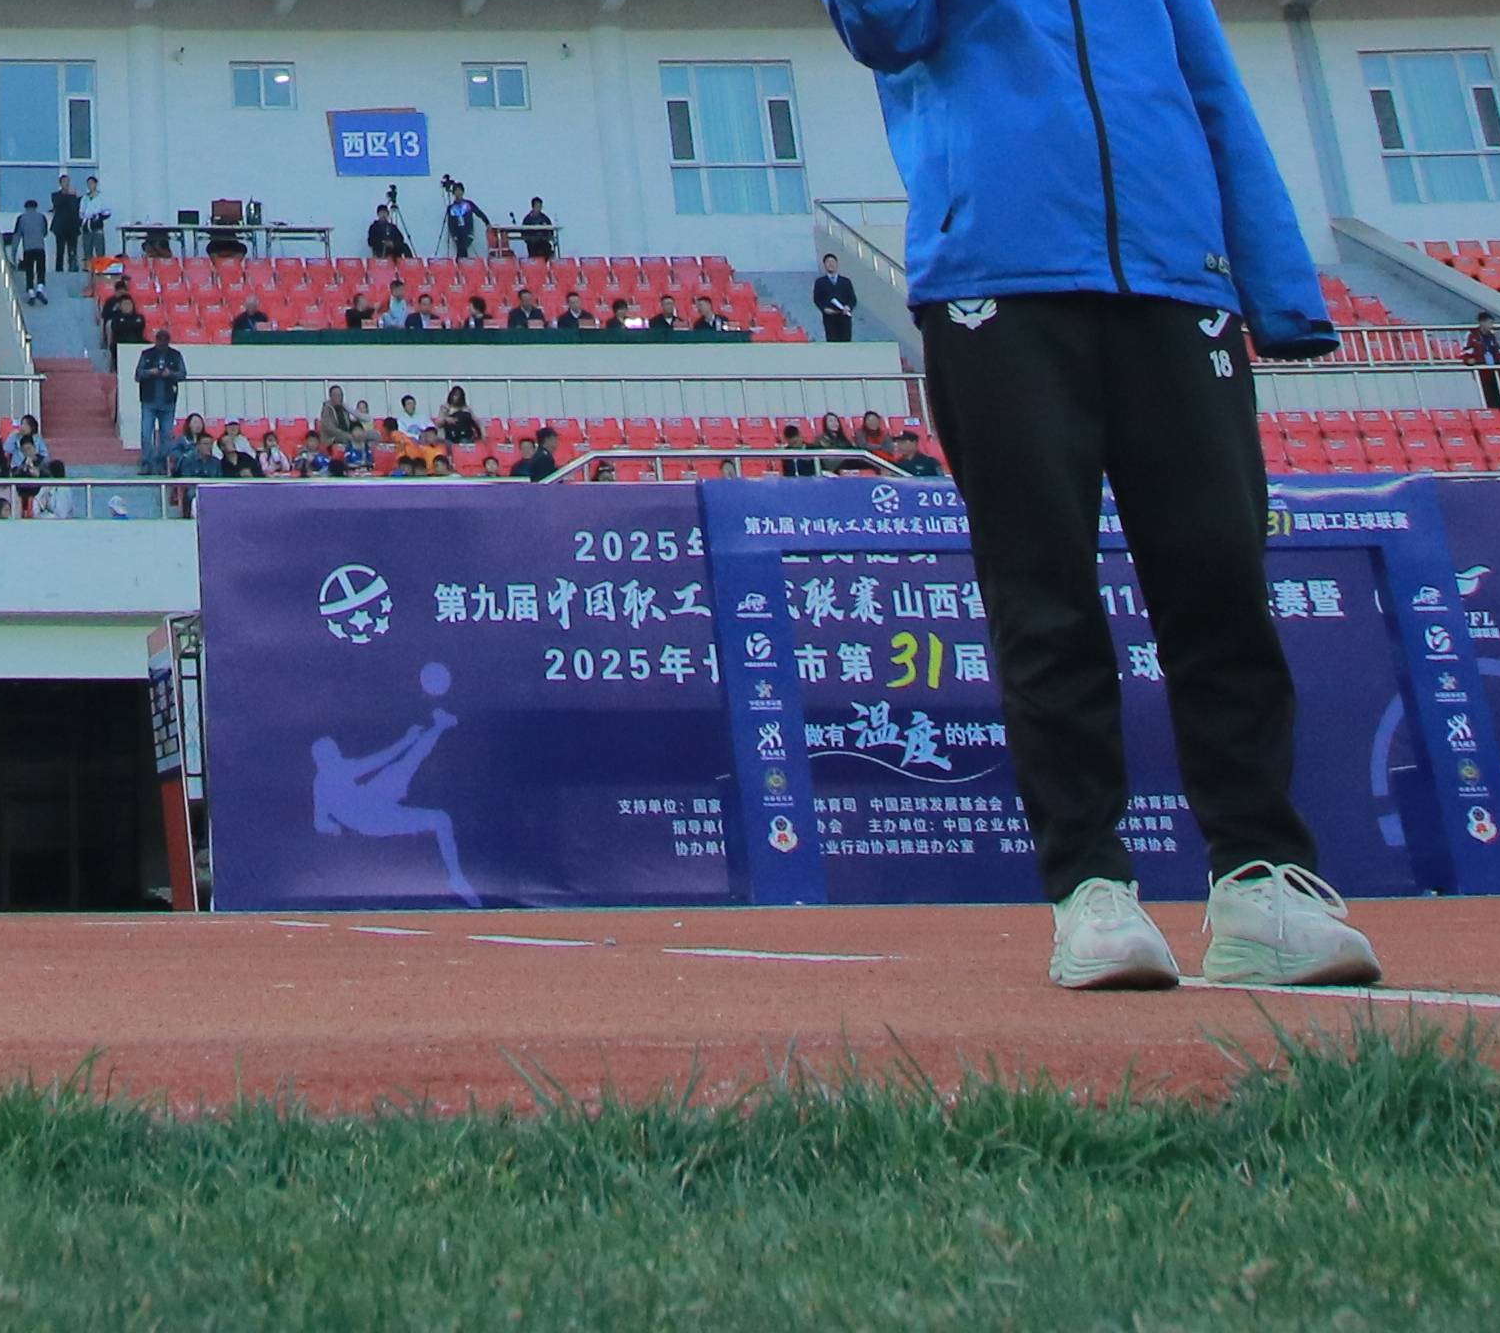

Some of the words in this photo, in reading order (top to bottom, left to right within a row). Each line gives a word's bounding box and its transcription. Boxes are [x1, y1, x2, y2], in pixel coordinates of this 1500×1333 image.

[341, 130, 420, 158] 西区13
[1209, 349, 1234, 379] 18
[917, 490, 966, 508] 202
